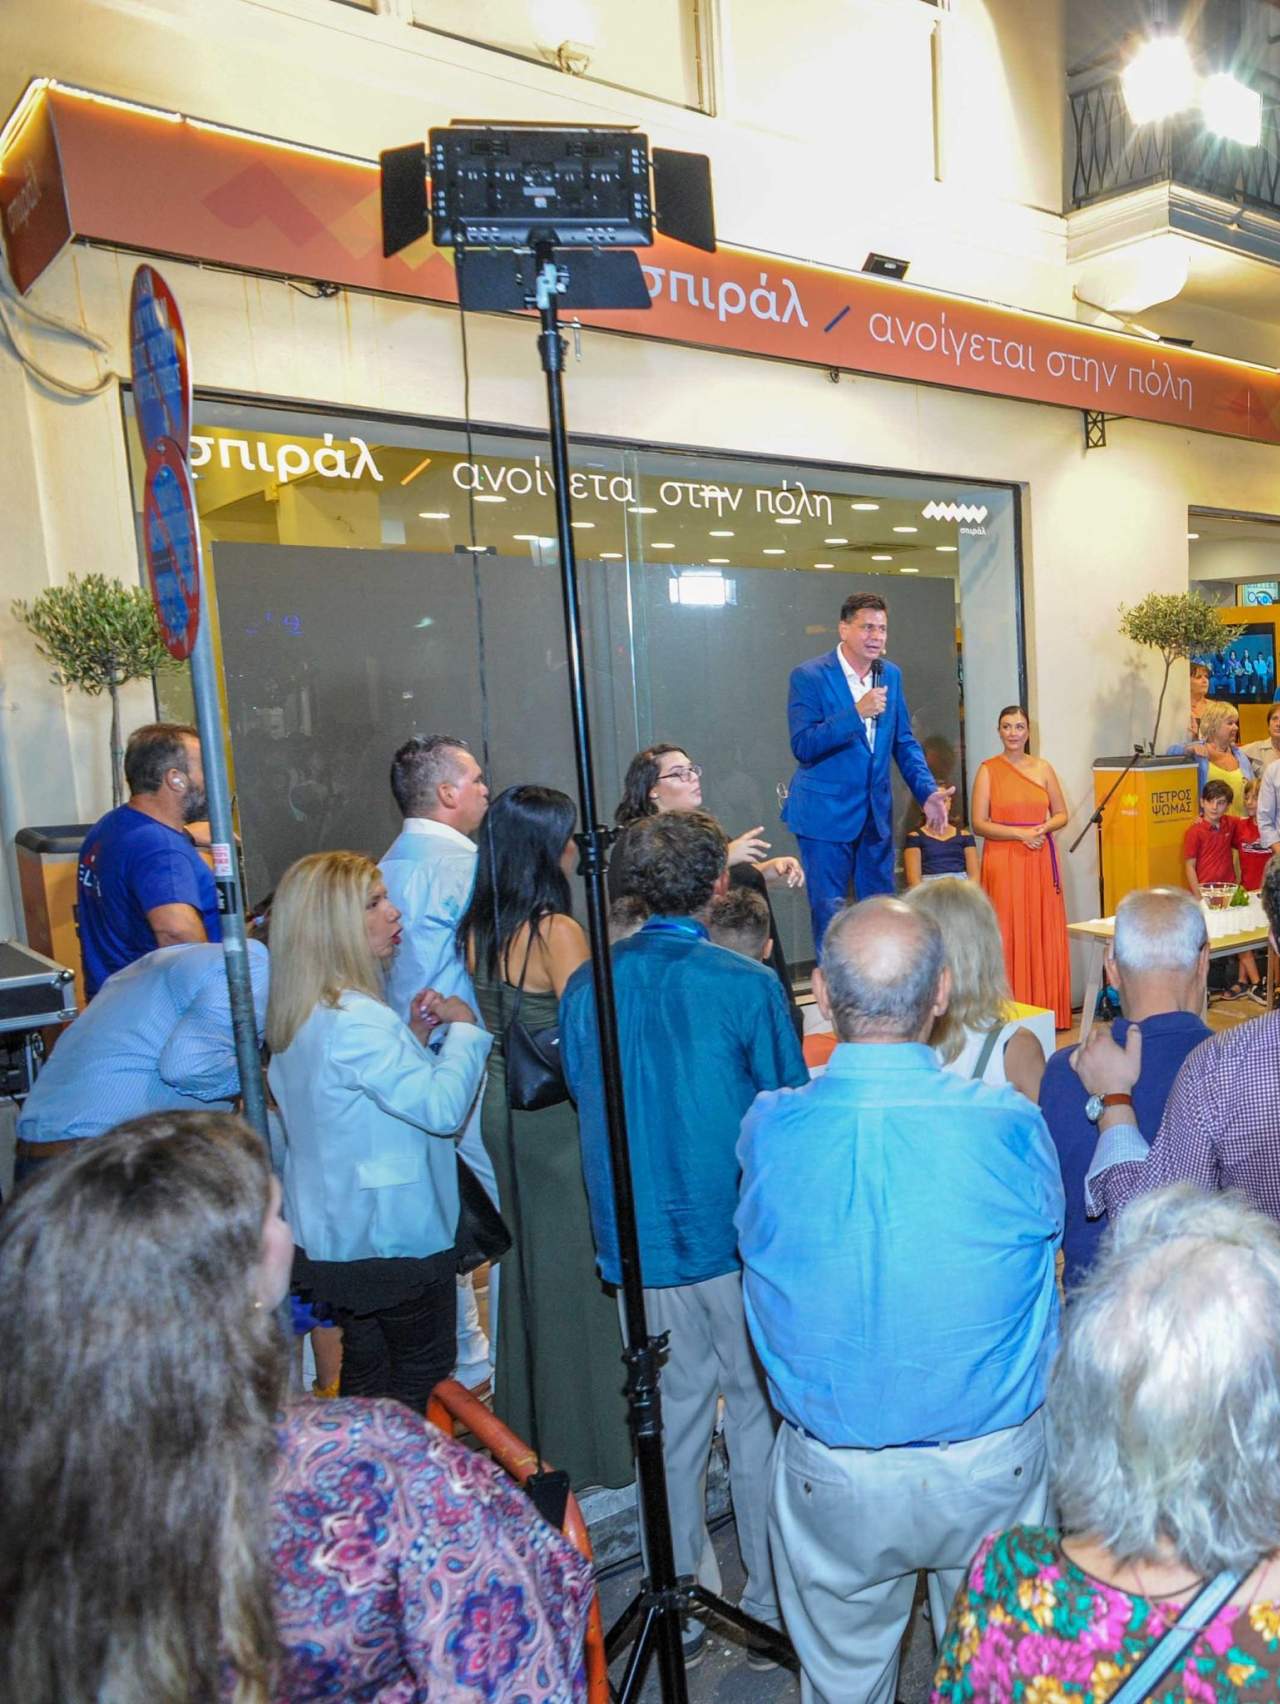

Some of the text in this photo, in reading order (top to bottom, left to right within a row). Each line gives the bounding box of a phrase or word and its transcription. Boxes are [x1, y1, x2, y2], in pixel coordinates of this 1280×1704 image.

[640, 266, 1193, 411] σπιράλ ανοίγεται στην πόλη
[189, 432, 384, 483] σπιράλ
[659, 480, 743, 517] στην
[755, 479, 833, 526] πόλη
[1151, 788, 1192, 804] ΠΕΤΡΟΣ
[1151, 801, 1192, 817] ΨΩΜΑΣ
